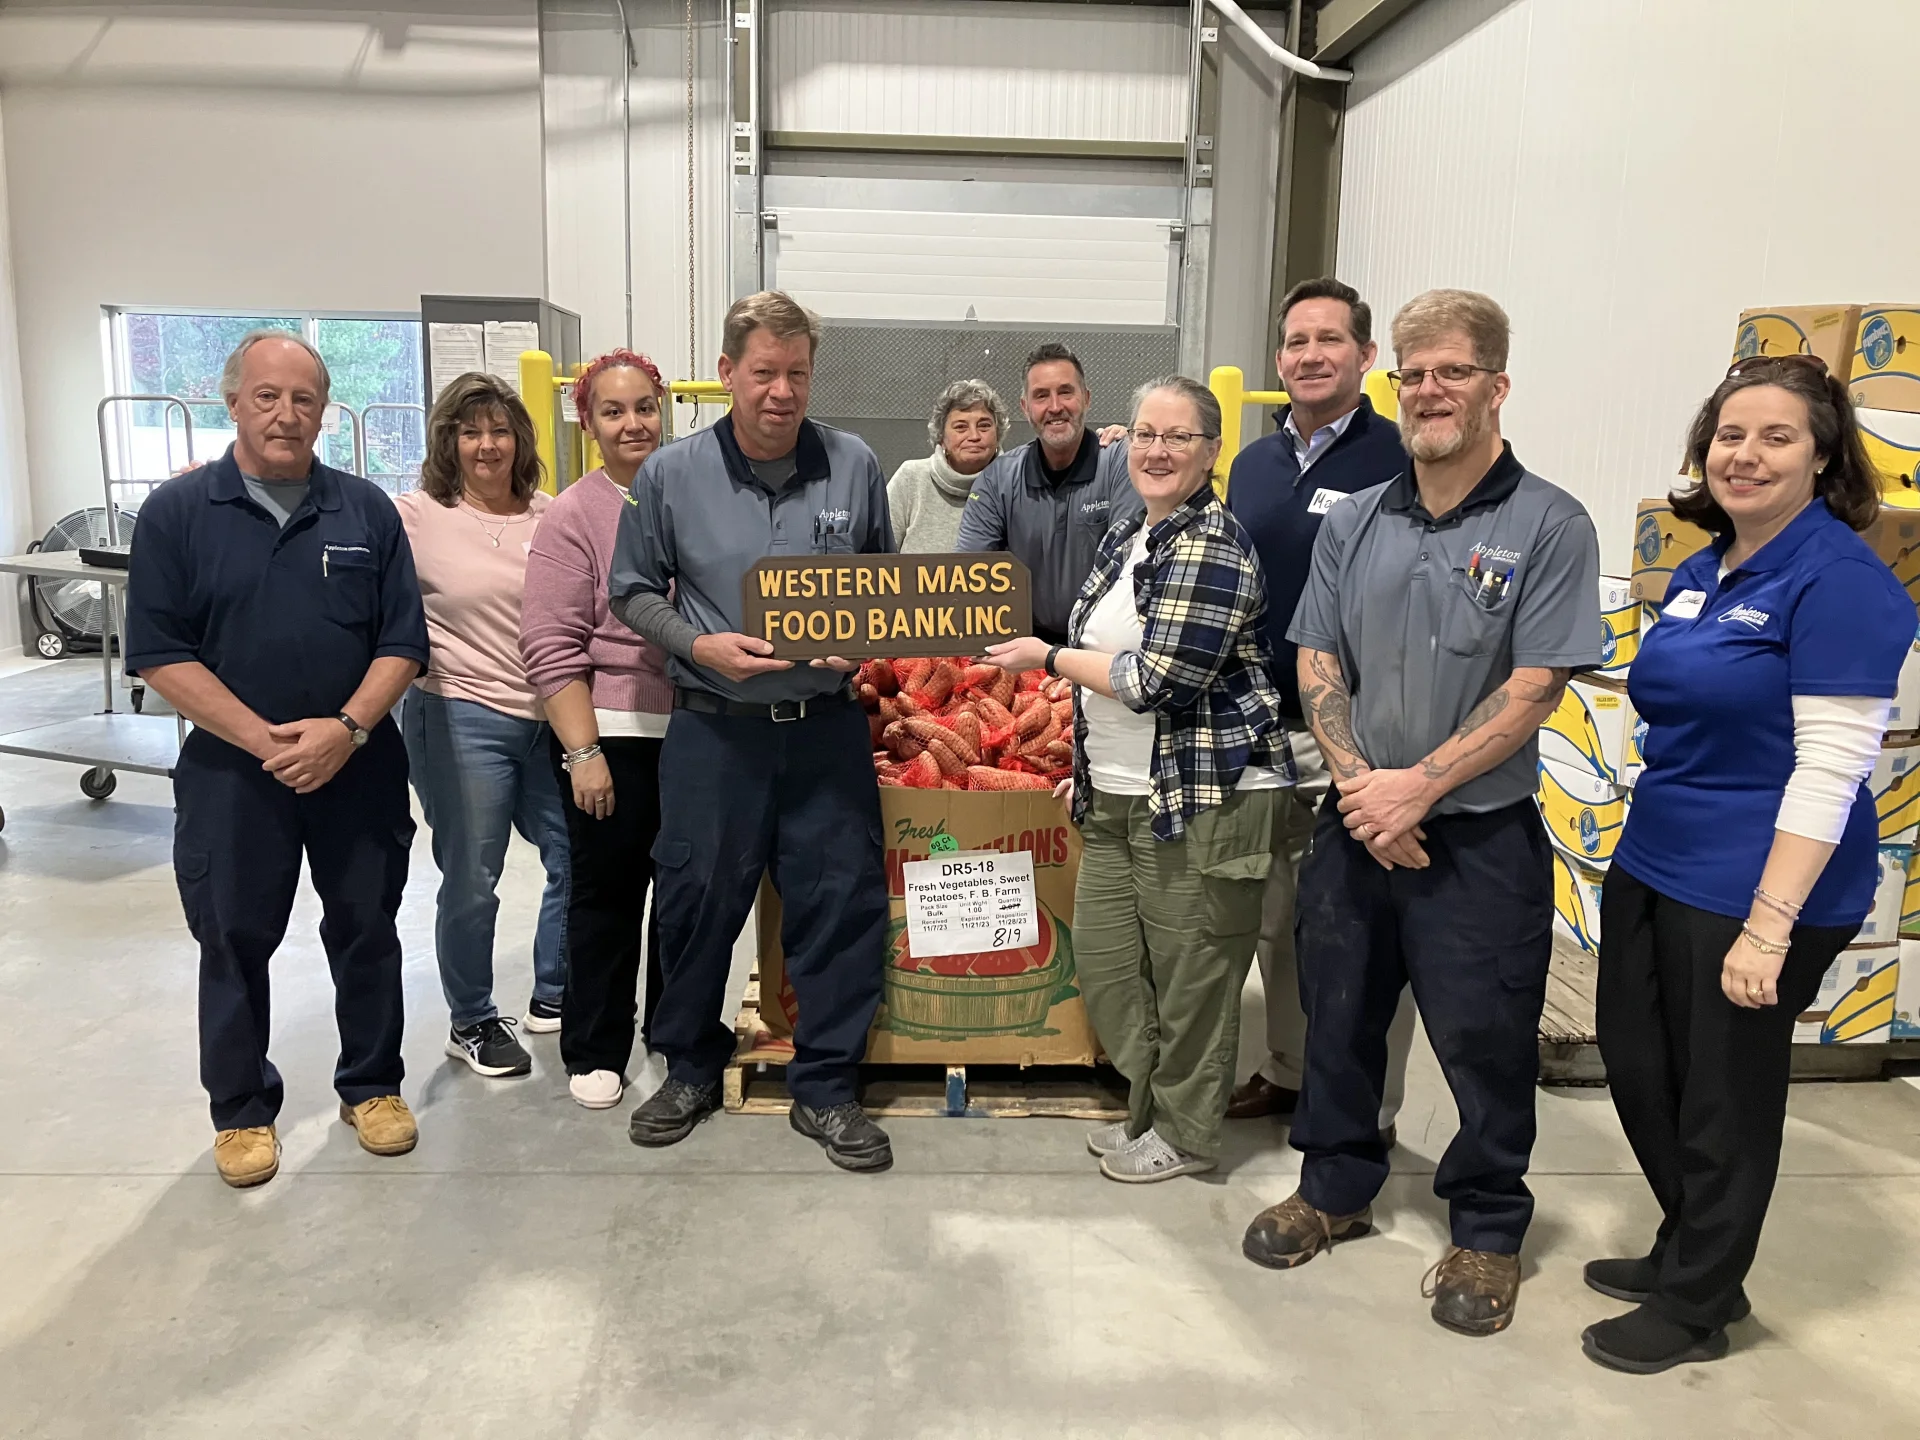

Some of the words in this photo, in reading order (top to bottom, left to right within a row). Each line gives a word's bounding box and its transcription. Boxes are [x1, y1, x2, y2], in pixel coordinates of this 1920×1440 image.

[1081, 500, 1109, 513] Appleton
[1469, 542, 1521, 559] Appleton
[759, 567, 900, 598] WESTERN
[917, 562, 1016, 593] MASS.
[764, 610, 856, 641] FOOD
[895, 818, 945, 844] Fresh
[942, 861, 994, 876] DR5-18
[909, 883, 936, 892] Fresh
[939, 878, 997, 891] Vegetables,
[999, 873, 1030, 884] Sweet
[920, 893, 967, 903] Potatoes,
[970, 890, 979, 898] F.
[982, 889, 992, 898] B.
[995, 887, 1021, 896] Farm
[992, 928, 1021, 947] 819
